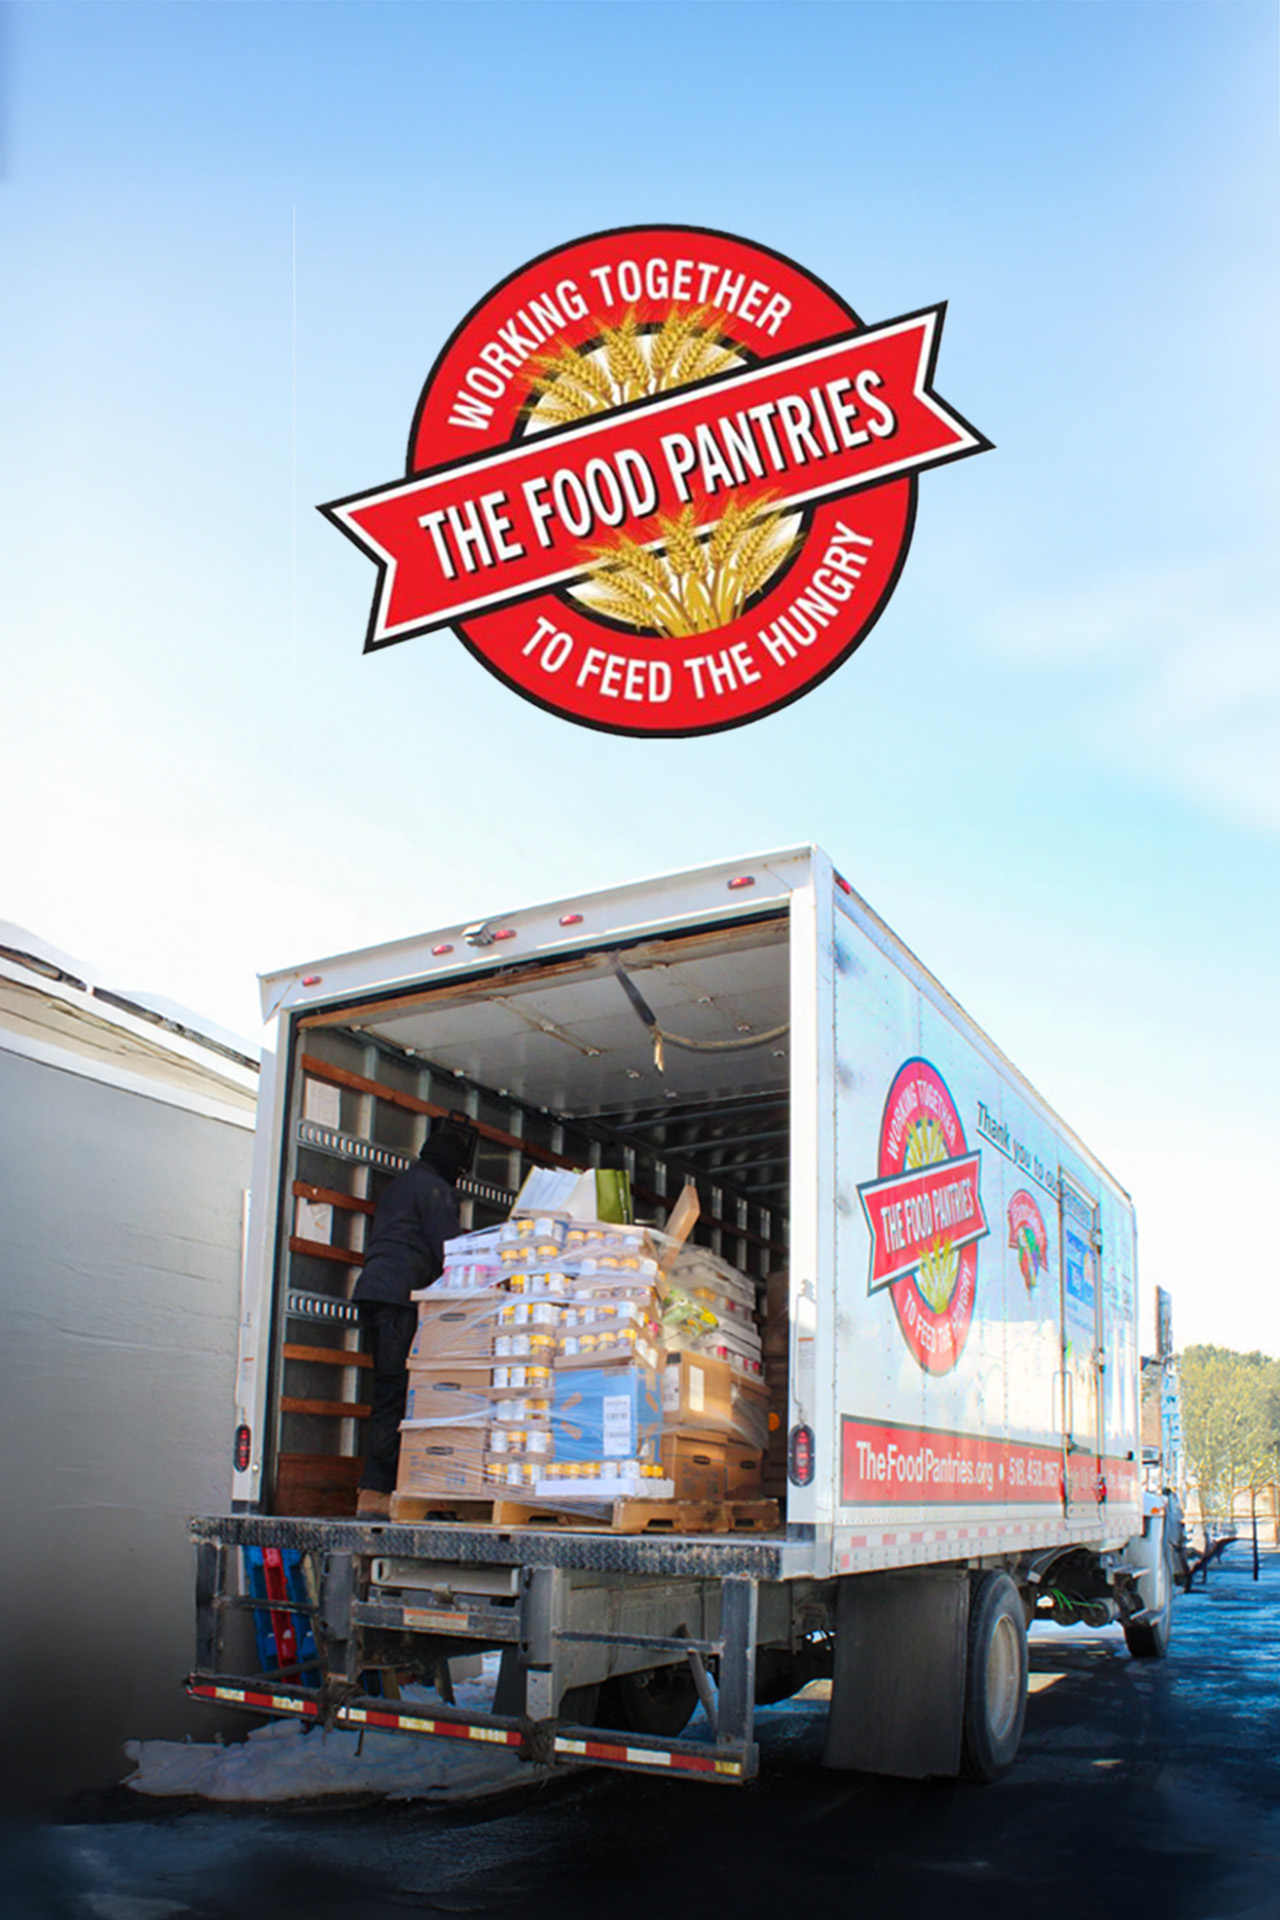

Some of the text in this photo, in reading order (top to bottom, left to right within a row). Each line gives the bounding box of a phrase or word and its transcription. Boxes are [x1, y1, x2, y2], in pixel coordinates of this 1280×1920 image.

[887, 1081, 918, 1161] WORKING
[977, 1100, 1011, 1152] Thank
[1012, 1139, 1031, 1165] you
[1034, 1155, 1044, 1180] to
[880, 1201, 907, 1255] THE
[904, 1192, 935, 1246] FOOD
[932, 1177, 976, 1233] PANTRIES
[904, 1289, 917, 1326] TO
[914, 1313, 936, 1353] FEED
[936, 1322, 952, 1353] THE
[856, 1441, 994, 1492] TheFoodPantries.org
